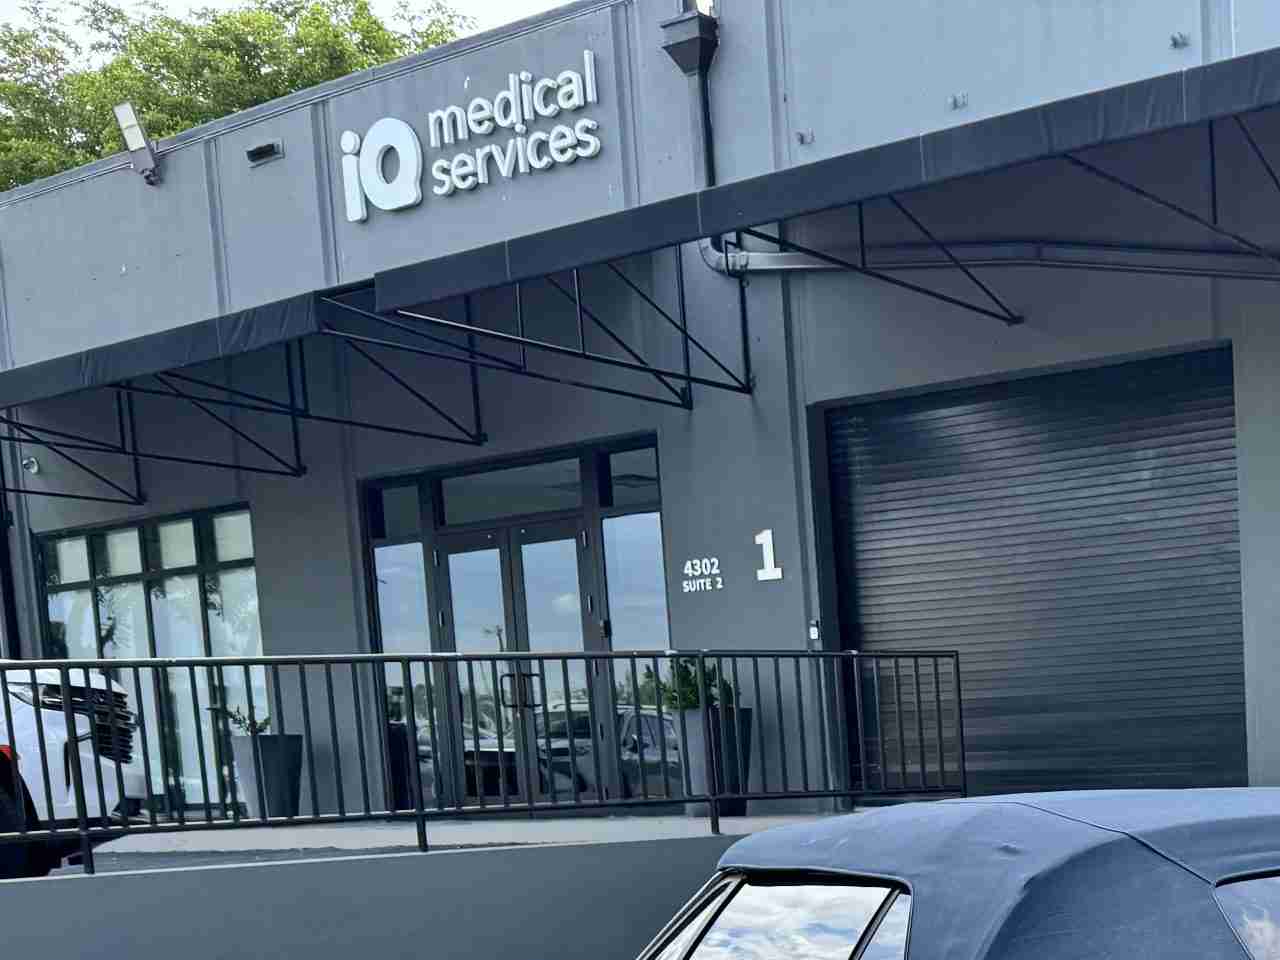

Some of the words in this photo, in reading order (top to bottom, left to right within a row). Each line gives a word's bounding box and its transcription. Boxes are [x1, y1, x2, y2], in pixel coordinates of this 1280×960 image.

[428, 49, 599, 148] medical
[431, 118, 601, 196] services
[683, 557, 720, 576] 4302
[754, 528, 783, 581] 1
[682, 578, 713, 592] SUITE
[715, 577, 724, 589] 2
